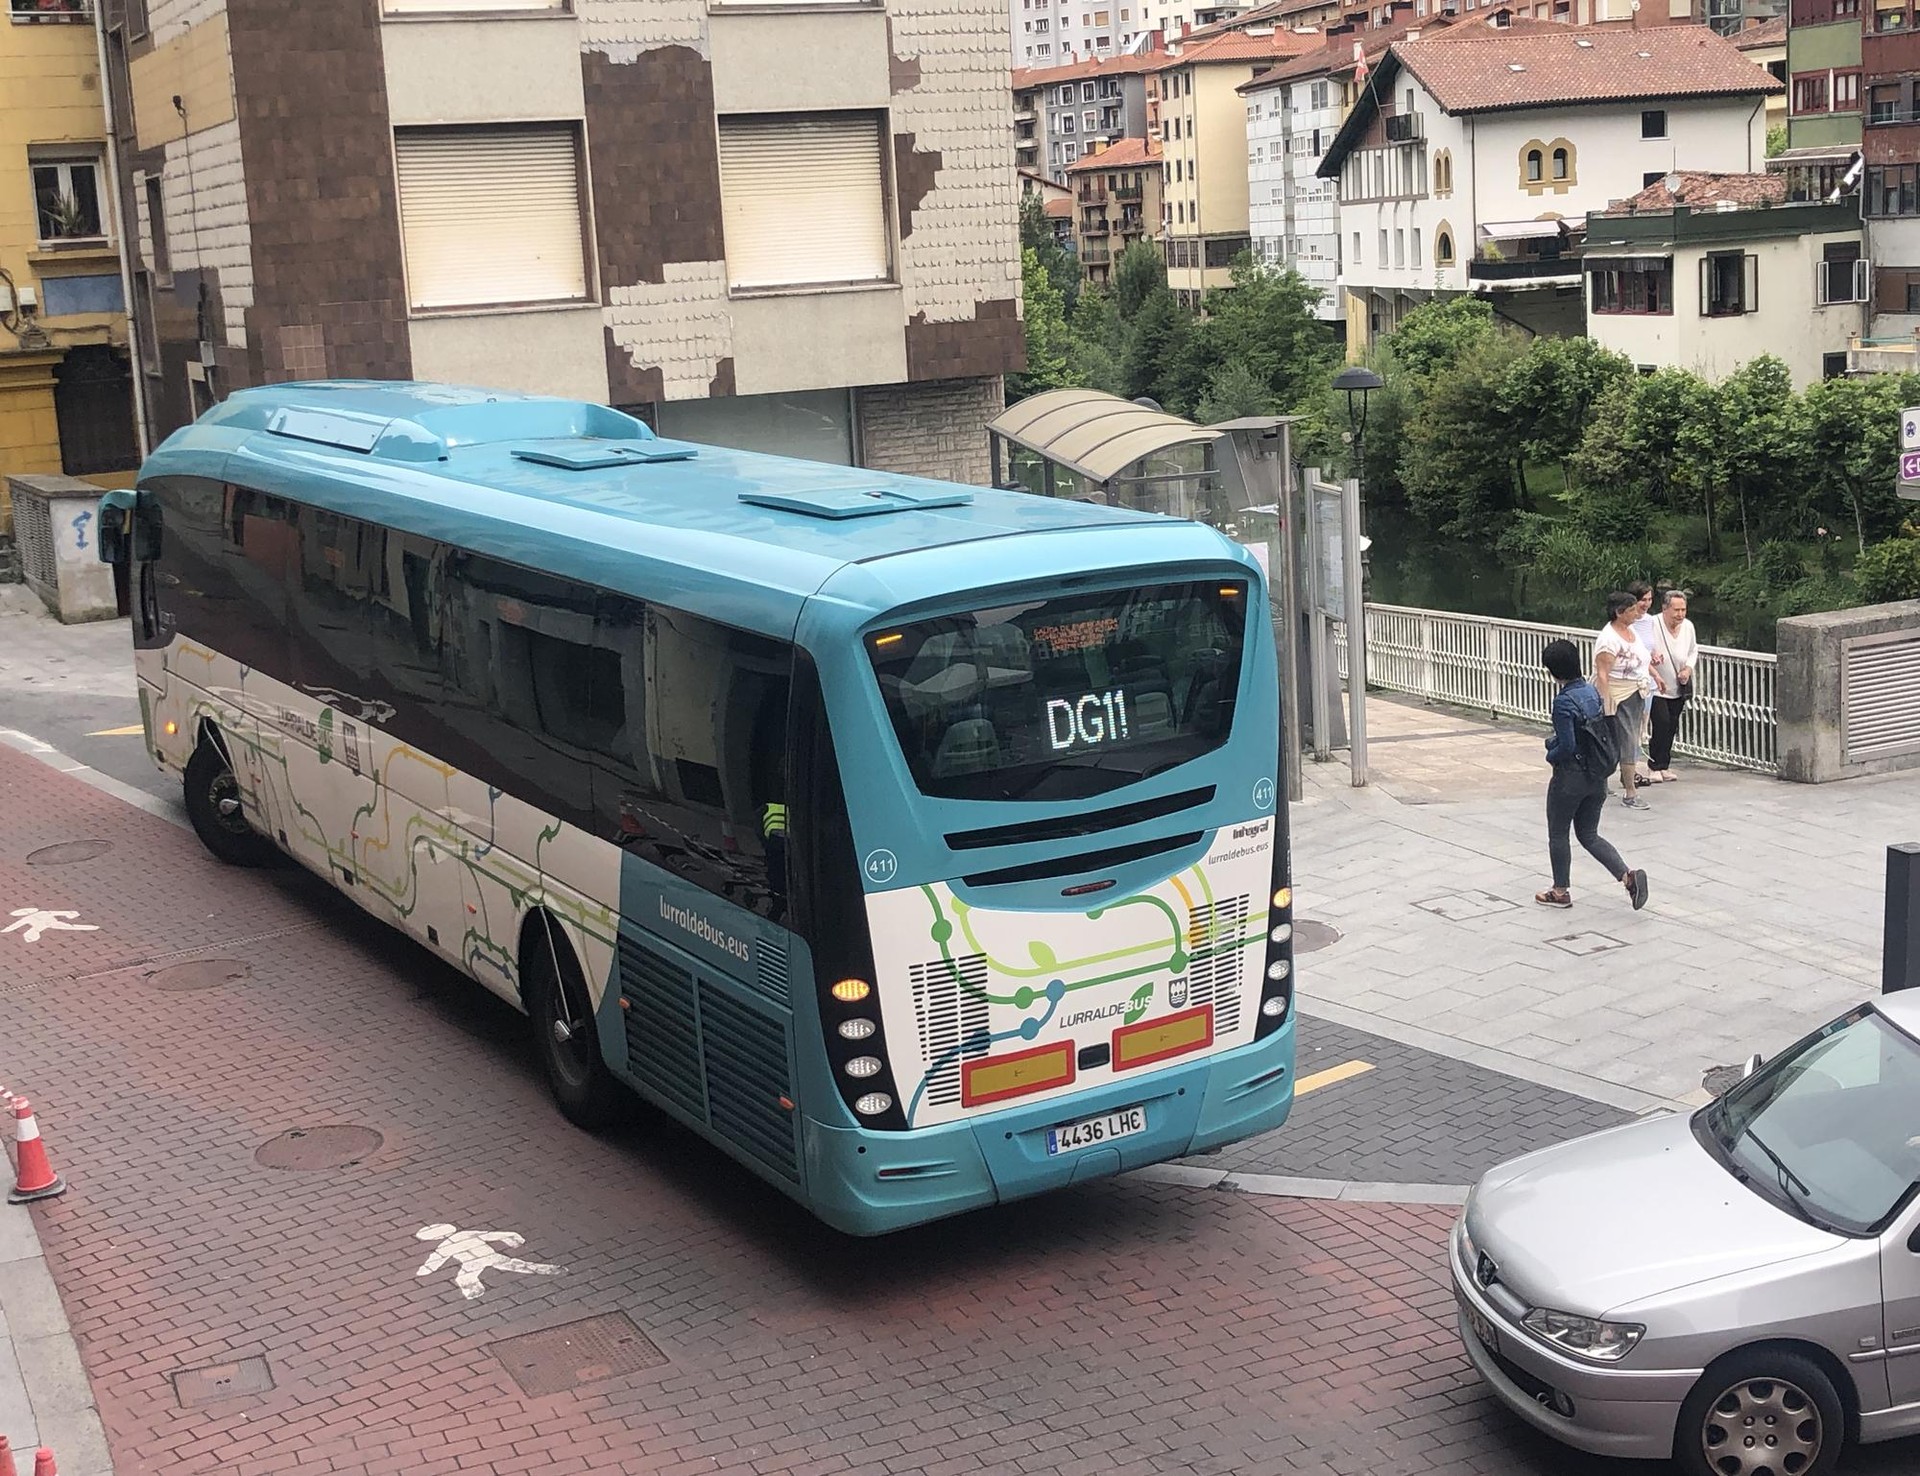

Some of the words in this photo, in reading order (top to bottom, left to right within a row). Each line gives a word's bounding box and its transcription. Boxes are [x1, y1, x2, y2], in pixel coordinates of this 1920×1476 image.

[1047, 690, 1128, 749] DG11
[1256, 786, 1272, 801] 411
[869, 858, 893, 873] 411
[1208, 842, 1269, 865] lurraldebus.eus
[660, 894, 750, 962] lurraldebus.eus
[1061, 1122, 1104, 1149] 4436
